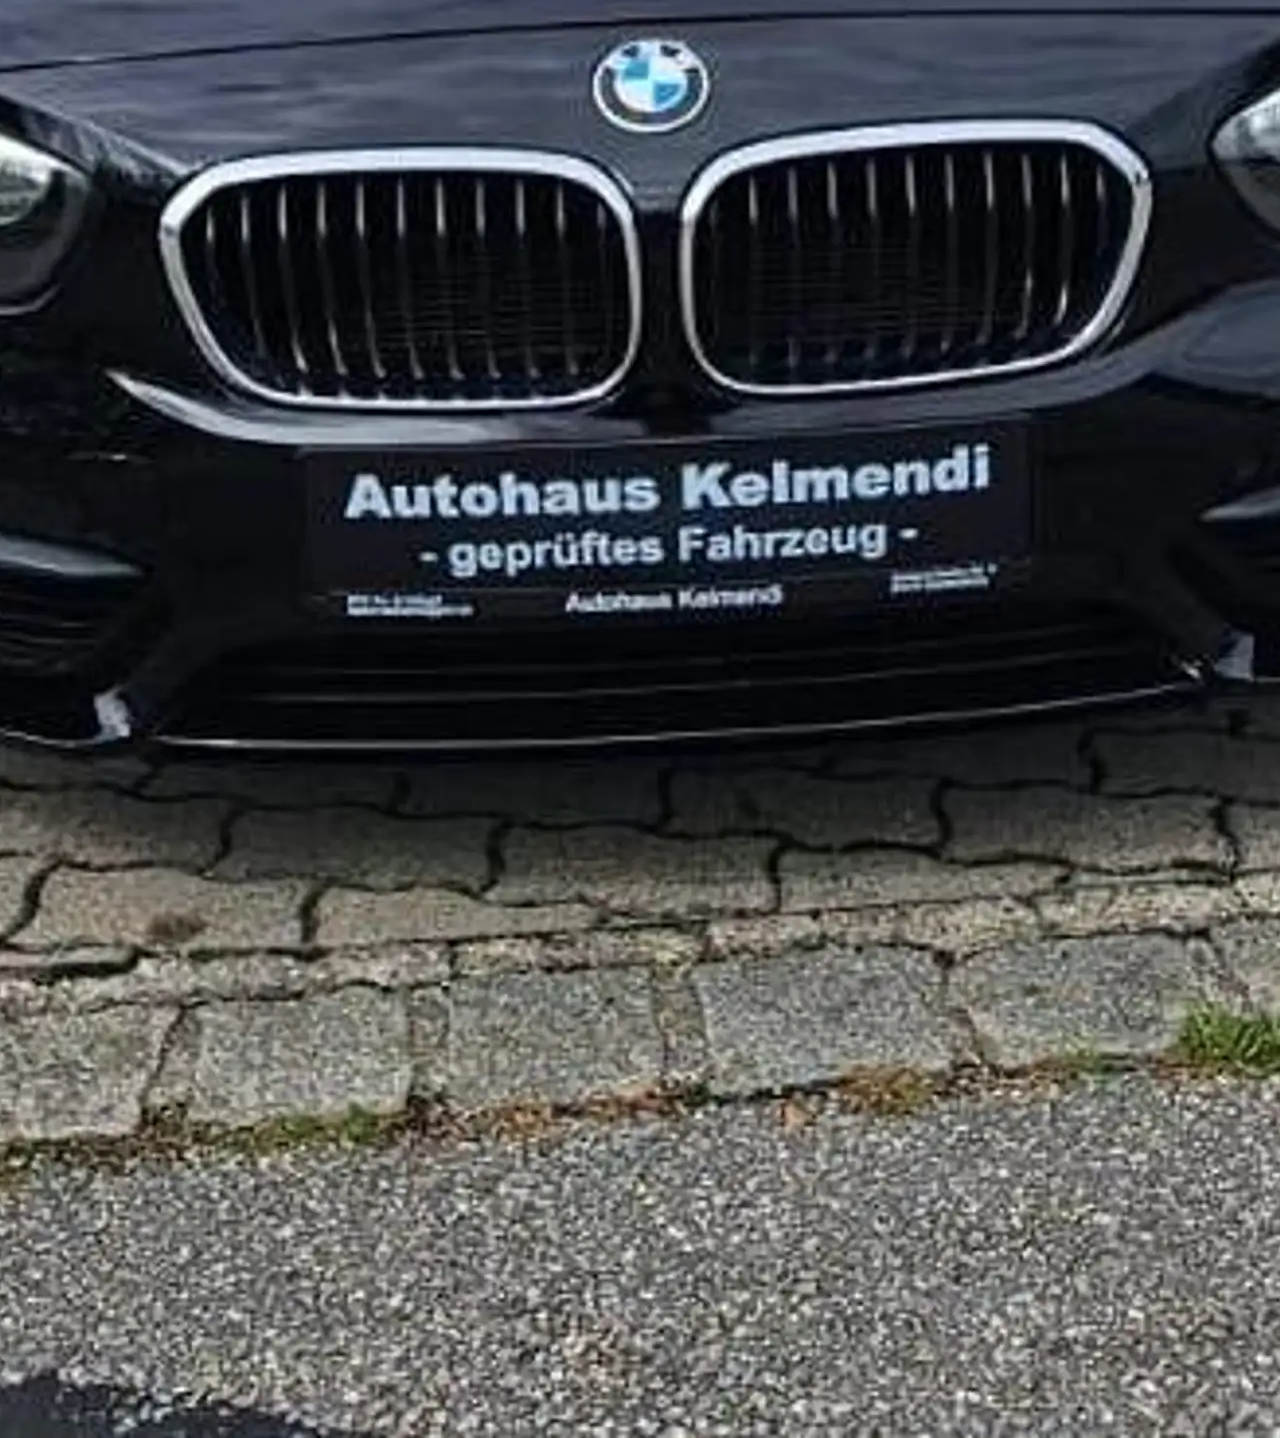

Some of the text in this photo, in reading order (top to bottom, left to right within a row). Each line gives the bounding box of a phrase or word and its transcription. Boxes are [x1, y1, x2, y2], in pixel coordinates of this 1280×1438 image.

[343, 441, 991, 519] Autohaus Kelmendi
[448, 530, 664, 577] geprüftes
[677, 523, 888, 562] Fahrzeug
